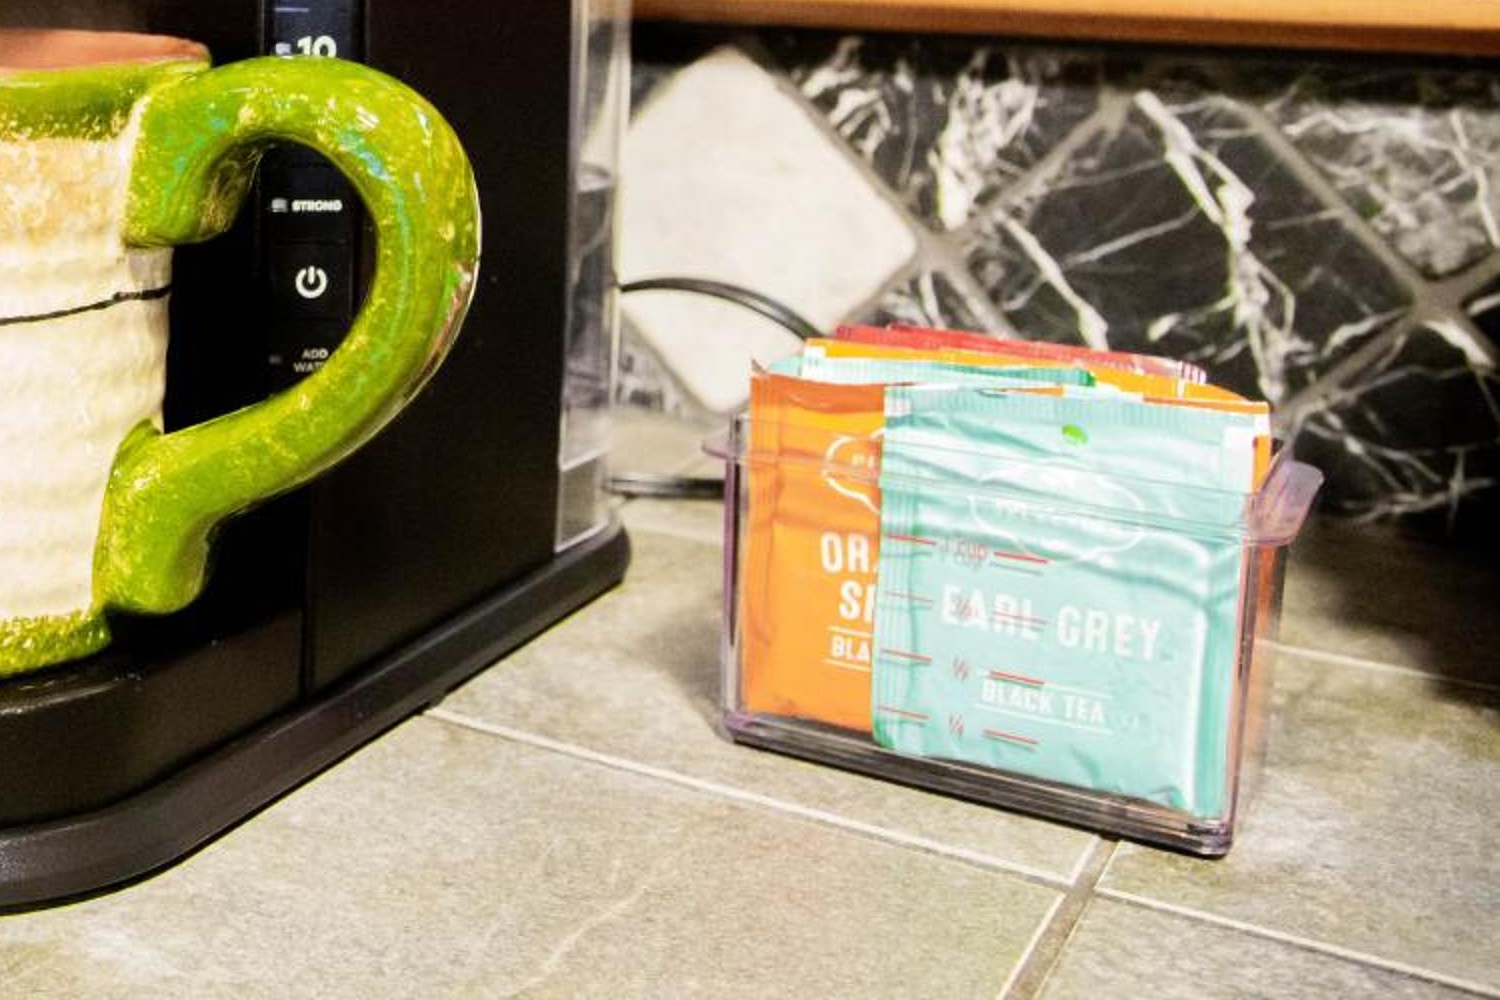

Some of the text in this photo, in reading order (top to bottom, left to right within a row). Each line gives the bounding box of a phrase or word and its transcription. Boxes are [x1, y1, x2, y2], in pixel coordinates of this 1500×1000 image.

[297, 36, 337, 58] 10
[292, 199, 343, 212] STRONG
[301, 348, 329, 359] ADD
[820, 531, 878, 574] OR
[941, 584, 1161, 661] EARL GREY
[982, 678, 1052, 713] BLACK
[1063, 696, 1106, 726] TEA
